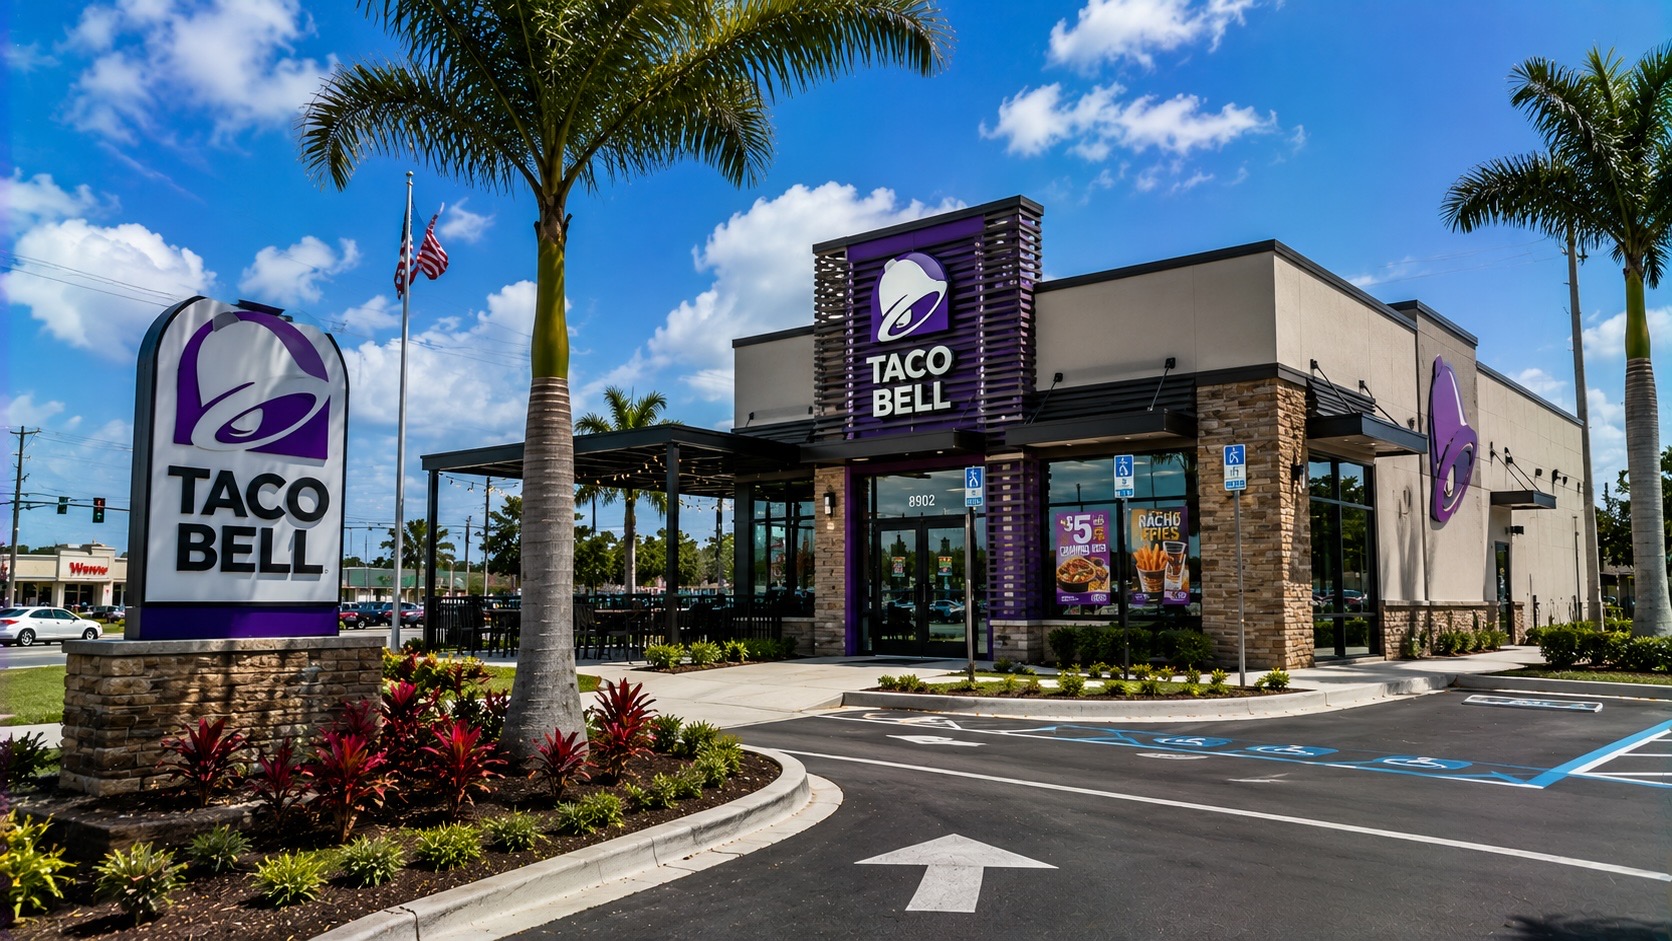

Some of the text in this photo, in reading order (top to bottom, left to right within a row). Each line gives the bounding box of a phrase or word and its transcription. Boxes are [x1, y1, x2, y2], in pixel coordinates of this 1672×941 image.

[866, 345, 953, 384] TACO
[872, 380, 951, 418] BELL
[168, 465, 330, 522] TACO
[908, 494, 936, 508] 8902
[176, 522, 324, 575] BELL
